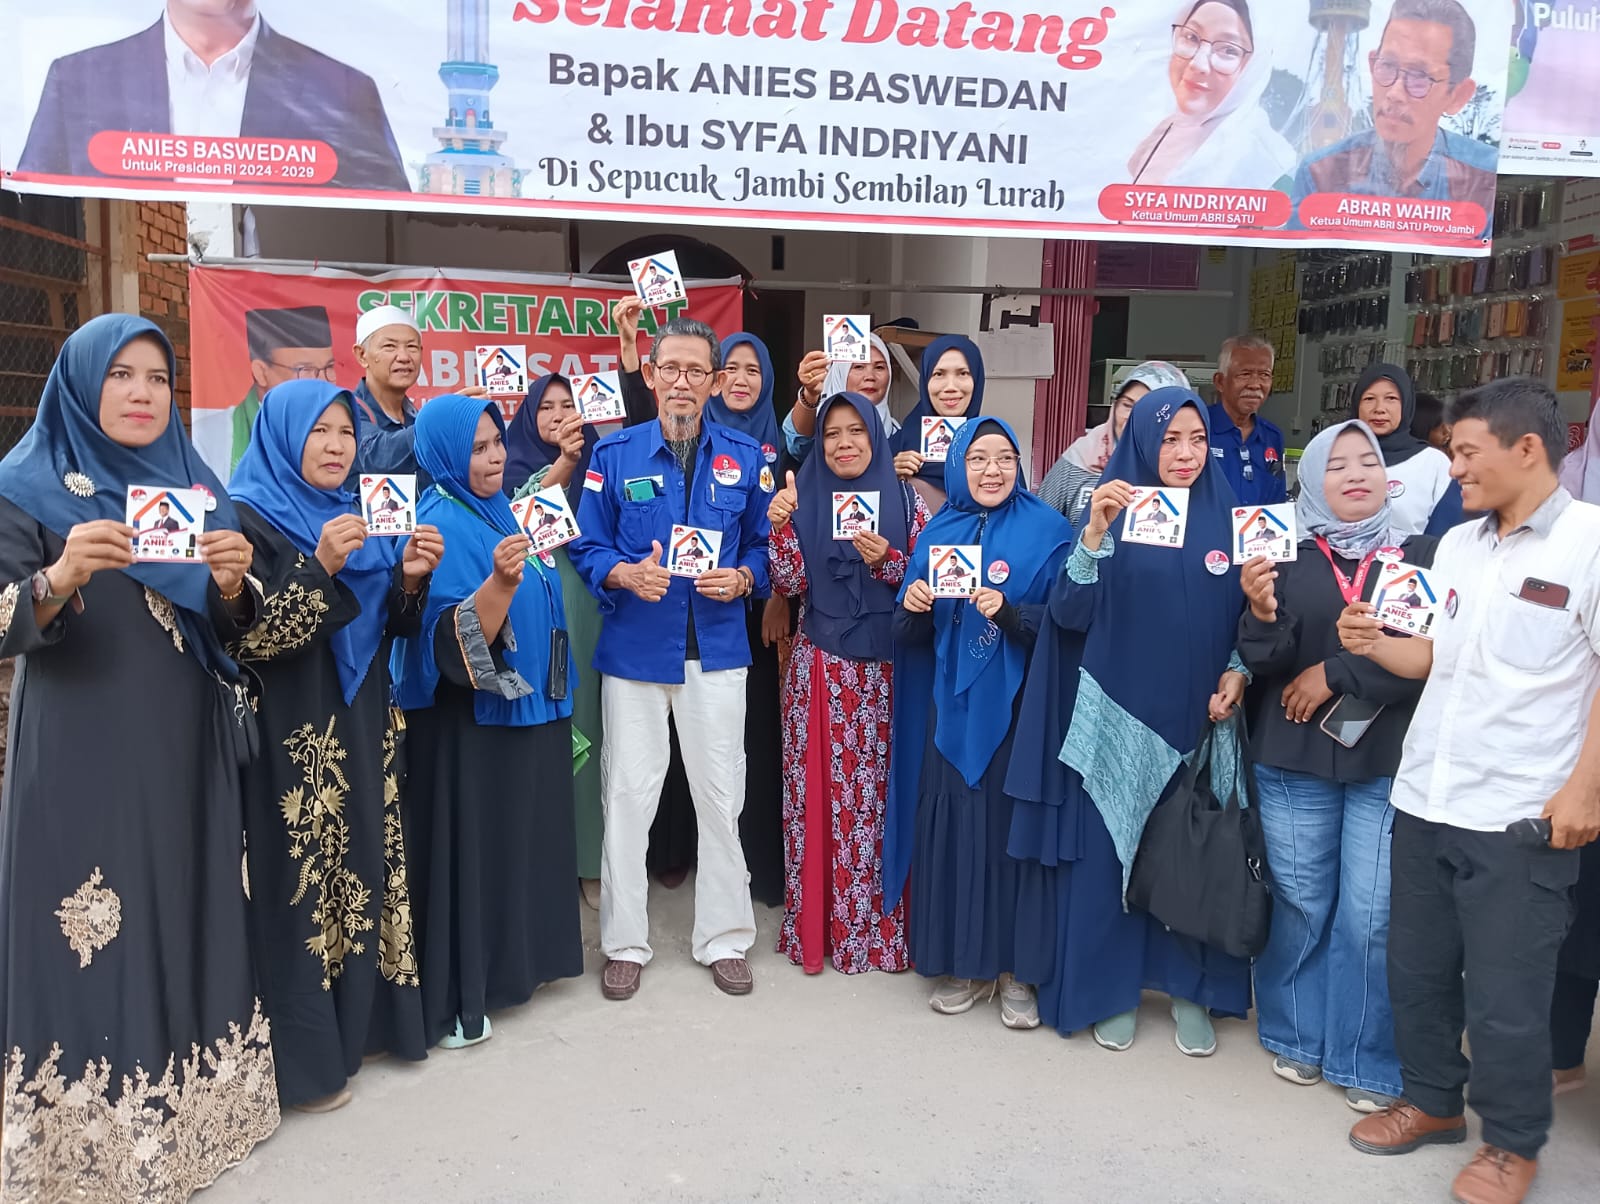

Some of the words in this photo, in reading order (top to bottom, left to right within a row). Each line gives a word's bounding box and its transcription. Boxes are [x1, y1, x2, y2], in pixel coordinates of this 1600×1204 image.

[841, 0, 1116, 70] Datang
[549, 53, 680, 96] Bapak
[689, 62, 817, 99] ANIES
[829, 70, 1068, 112] BASWEDAN
[588, 112, 613, 145] &
[625, 114, 689, 148] Ibu
[701, 119, 808, 155] SYFA
[819, 125, 1028, 164] INDRIYANI
[122, 138, 188, 157] ANIES
[193, 141, 317, 163] BASWEDAN
[122, 158, 161, 171] Untuk
[165, 160, 221, 174] Presiden
[224, 164, 236, 175] RI
[240, 164, 272, 176] 2024
[281, 166, 315, 178] 2029
[538, 157, 578, 187] Di
[588, 160, 726, 200] Sepucuk
[733, 167, 825, 201] Jambi
[833, 171, 968, 208] Sembilan
[976, 178, 1065, 212] Lurah
[1124, 191, 1168, 208] SYFA
[1173, 194, 1267, 212] INDRIYANI
[1337, 198, 1391, 217] ABRAR
[1396, 203, 1452, 221] WAHIR
[1132, 210, 1162, 221] Ketua
[1164, 212, 1198, 222] Umum
[1200, 212, 1225, 223] ABRI
[1227, 213, 1255, 224] SATU
[1310, 216, 1340, 226] Ketua
[1343, 217, 1372, 228] Umum
[1373, 219, 1395, 229] ABRI
[1397, 221, 1421, 231] SATU
[1423, 223, 1444, 233] Prov
[1446, 224, 1475, 235] Jambi
[1384, 606, 1412, 620] ANIES
